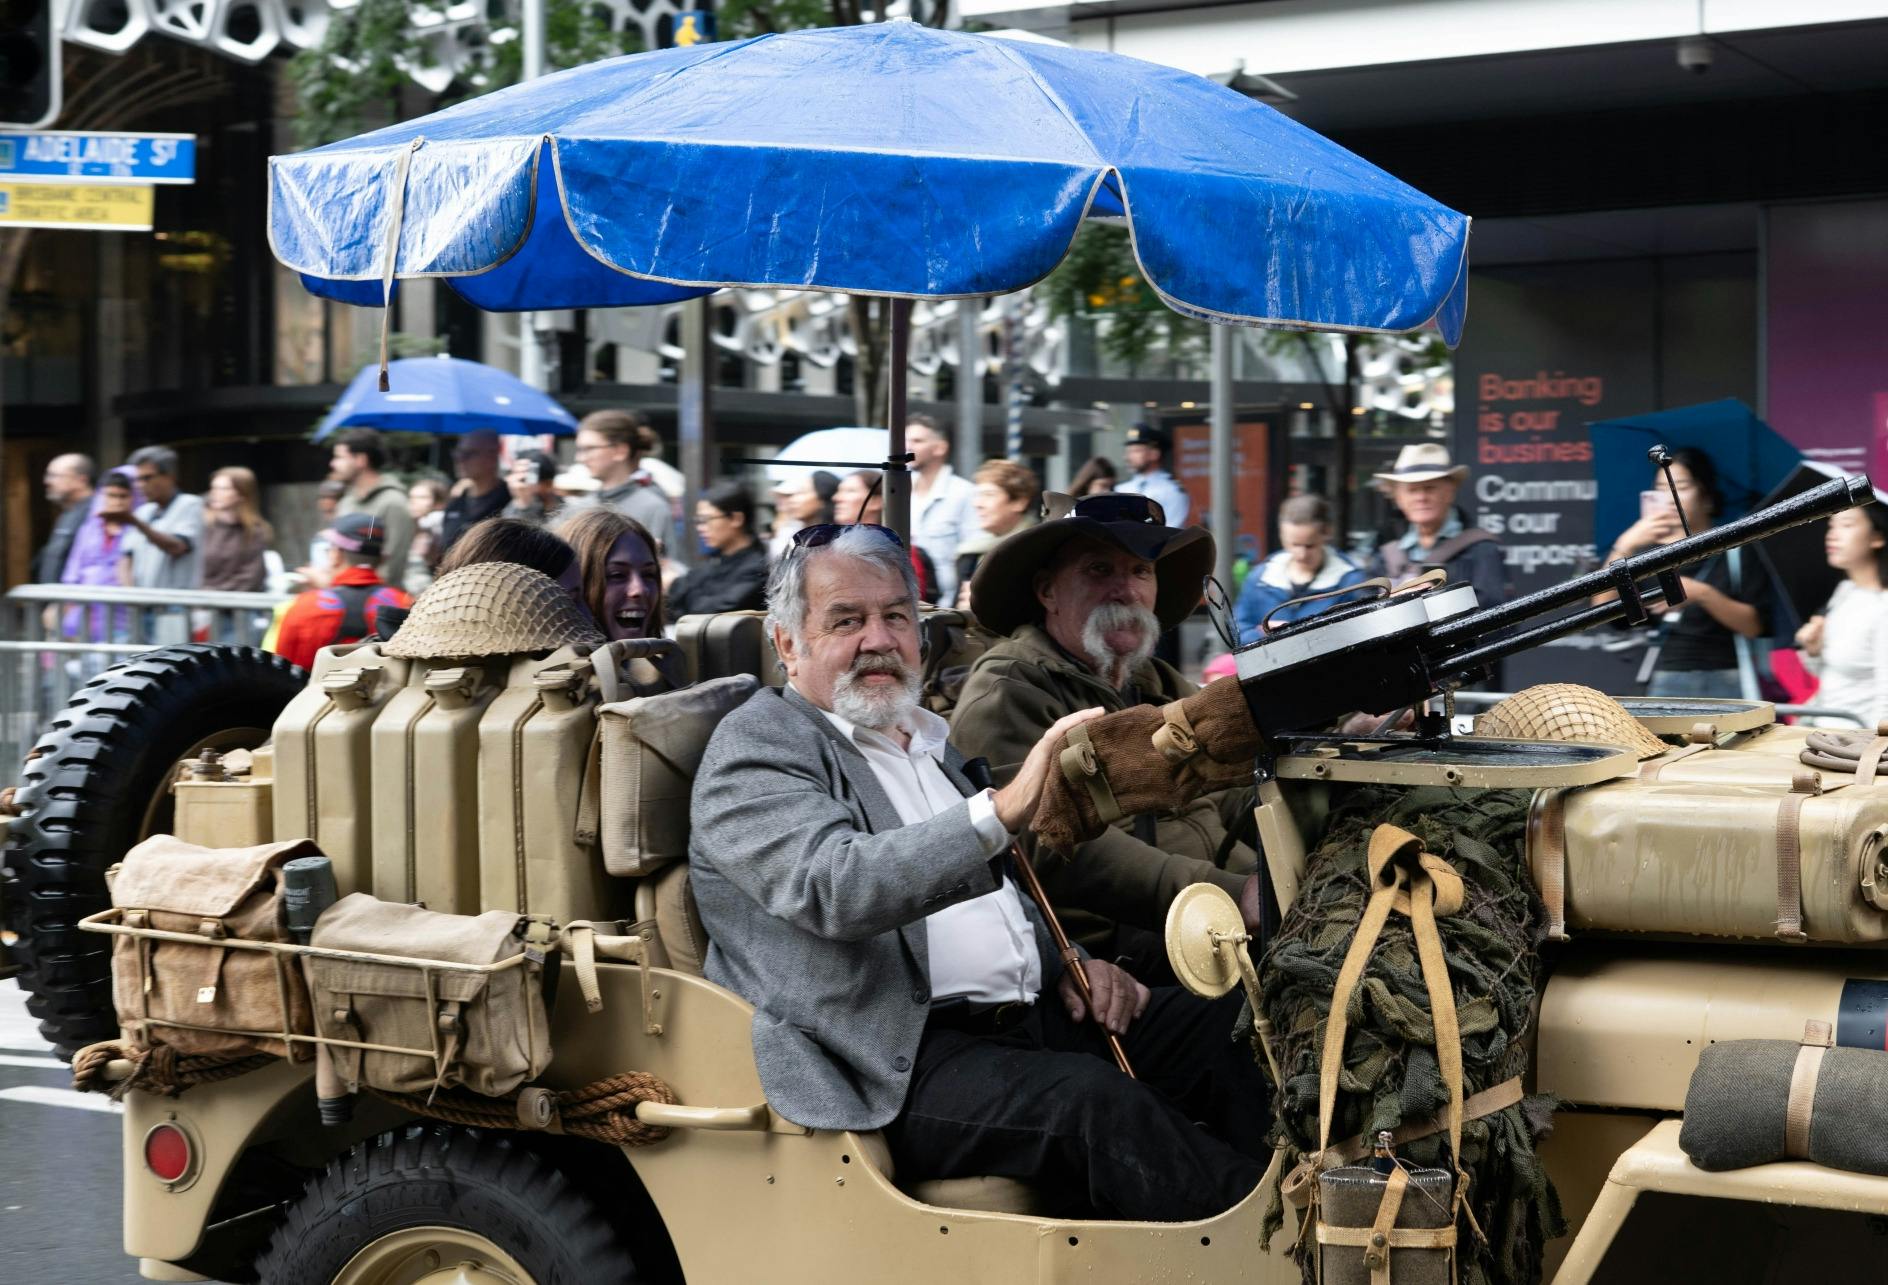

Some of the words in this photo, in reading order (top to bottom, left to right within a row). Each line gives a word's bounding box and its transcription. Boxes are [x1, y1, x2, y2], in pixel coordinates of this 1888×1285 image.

[23, 135, 140, 165] ADELAIDE
[1478, 370, 1602, 406] Banking
[1477, 406, 1505, 432] is
[1509, 410, 1561, 431] our
[1477, 435, 1594, 464] busines
[1475, 474, 1598, 503] Commu
[1477, 507, 1505, 534] is
[1508, 512, 1562, 533] our
